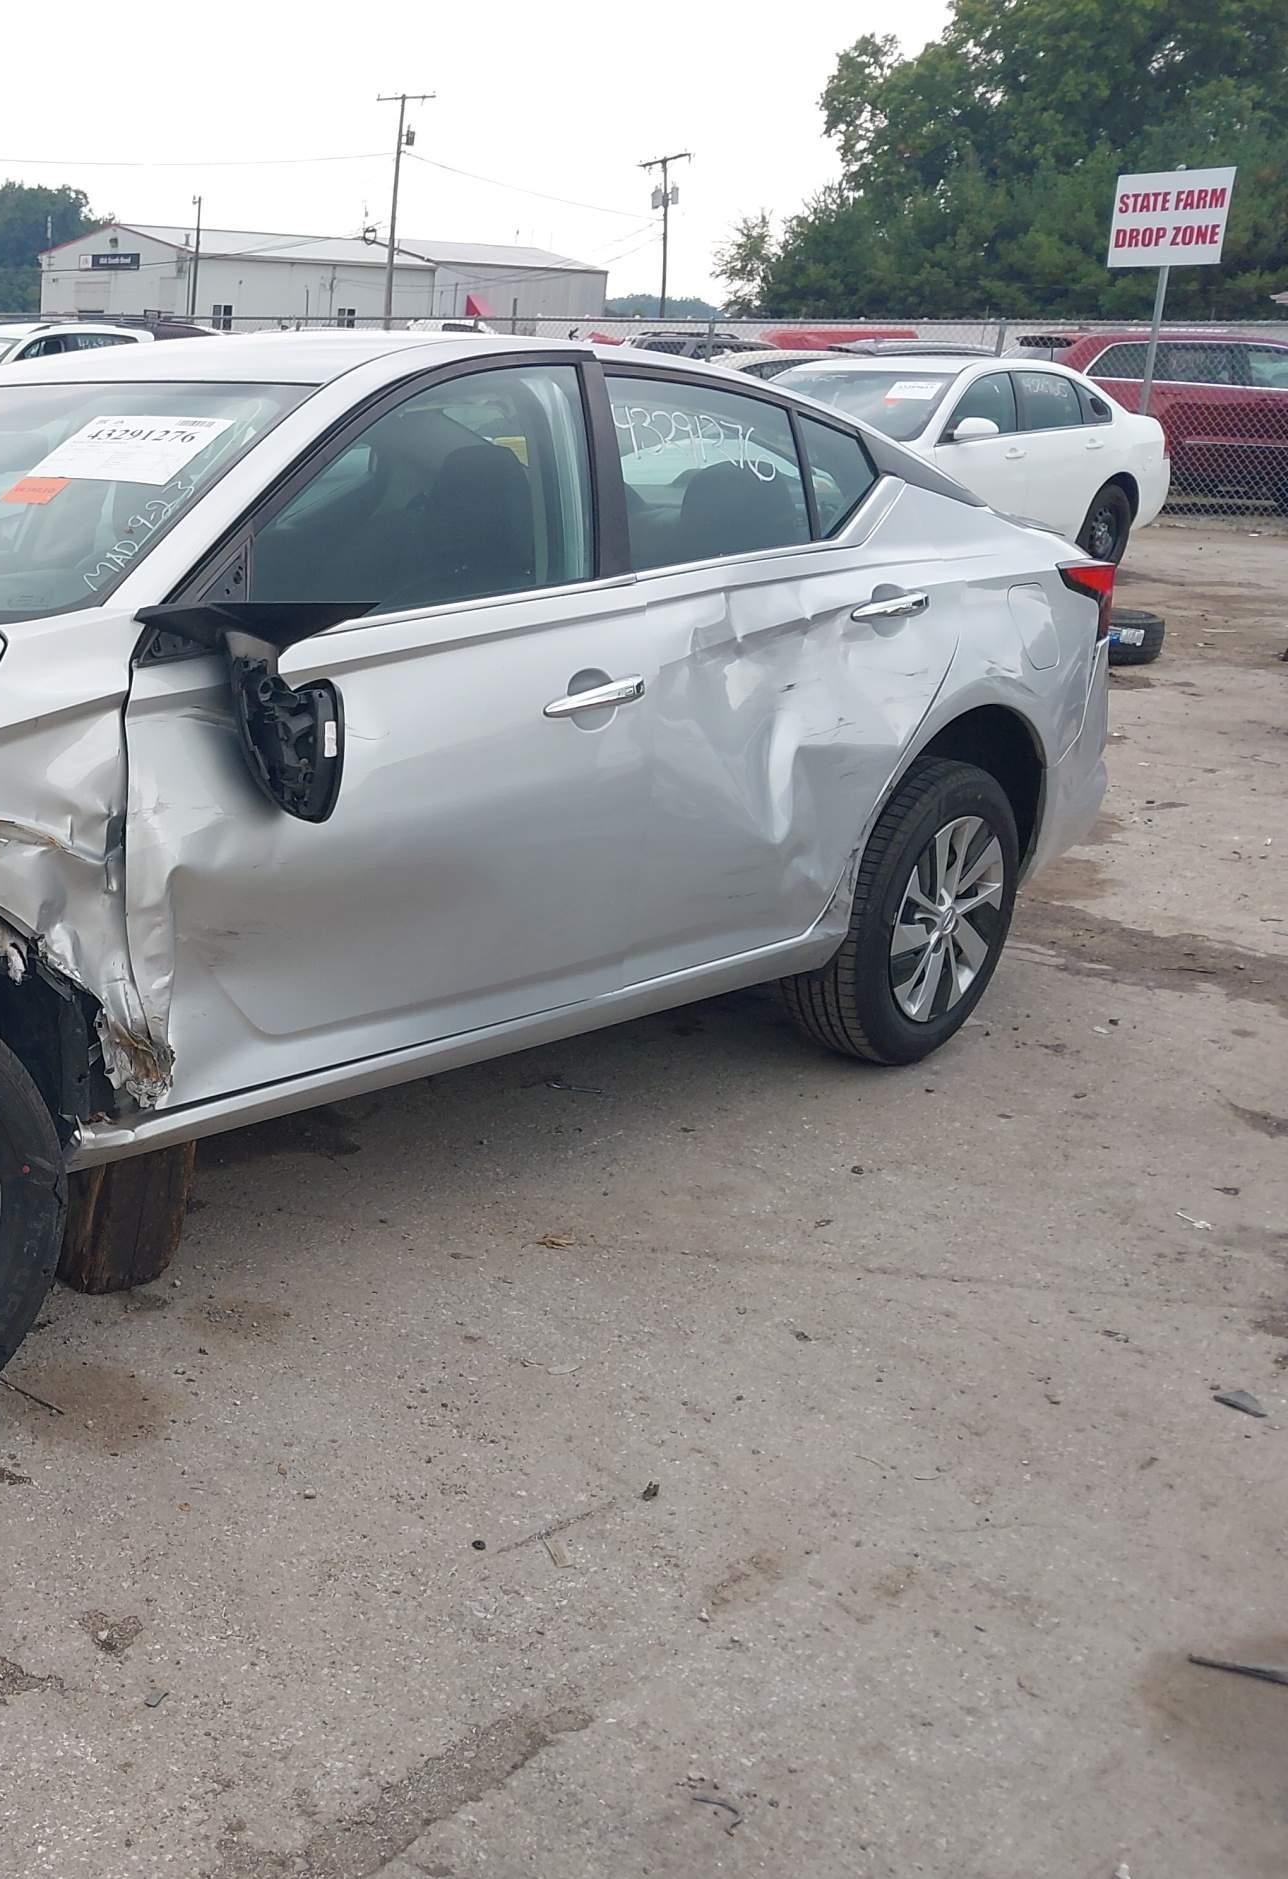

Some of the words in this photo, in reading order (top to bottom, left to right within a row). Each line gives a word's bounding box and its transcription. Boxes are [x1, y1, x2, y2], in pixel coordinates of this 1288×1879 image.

[1118, 191, 1171, 214] STATE
[1174, 187, 1227, 210] FARM
[1114, 227, 1167, 248] DROP
[1170, 224, 1221, 246] ZONE
[87, 428, 200, 443] 43291276
[611, 403, 776, 481] 43291276
[83, 540, 139, 591] MAD
